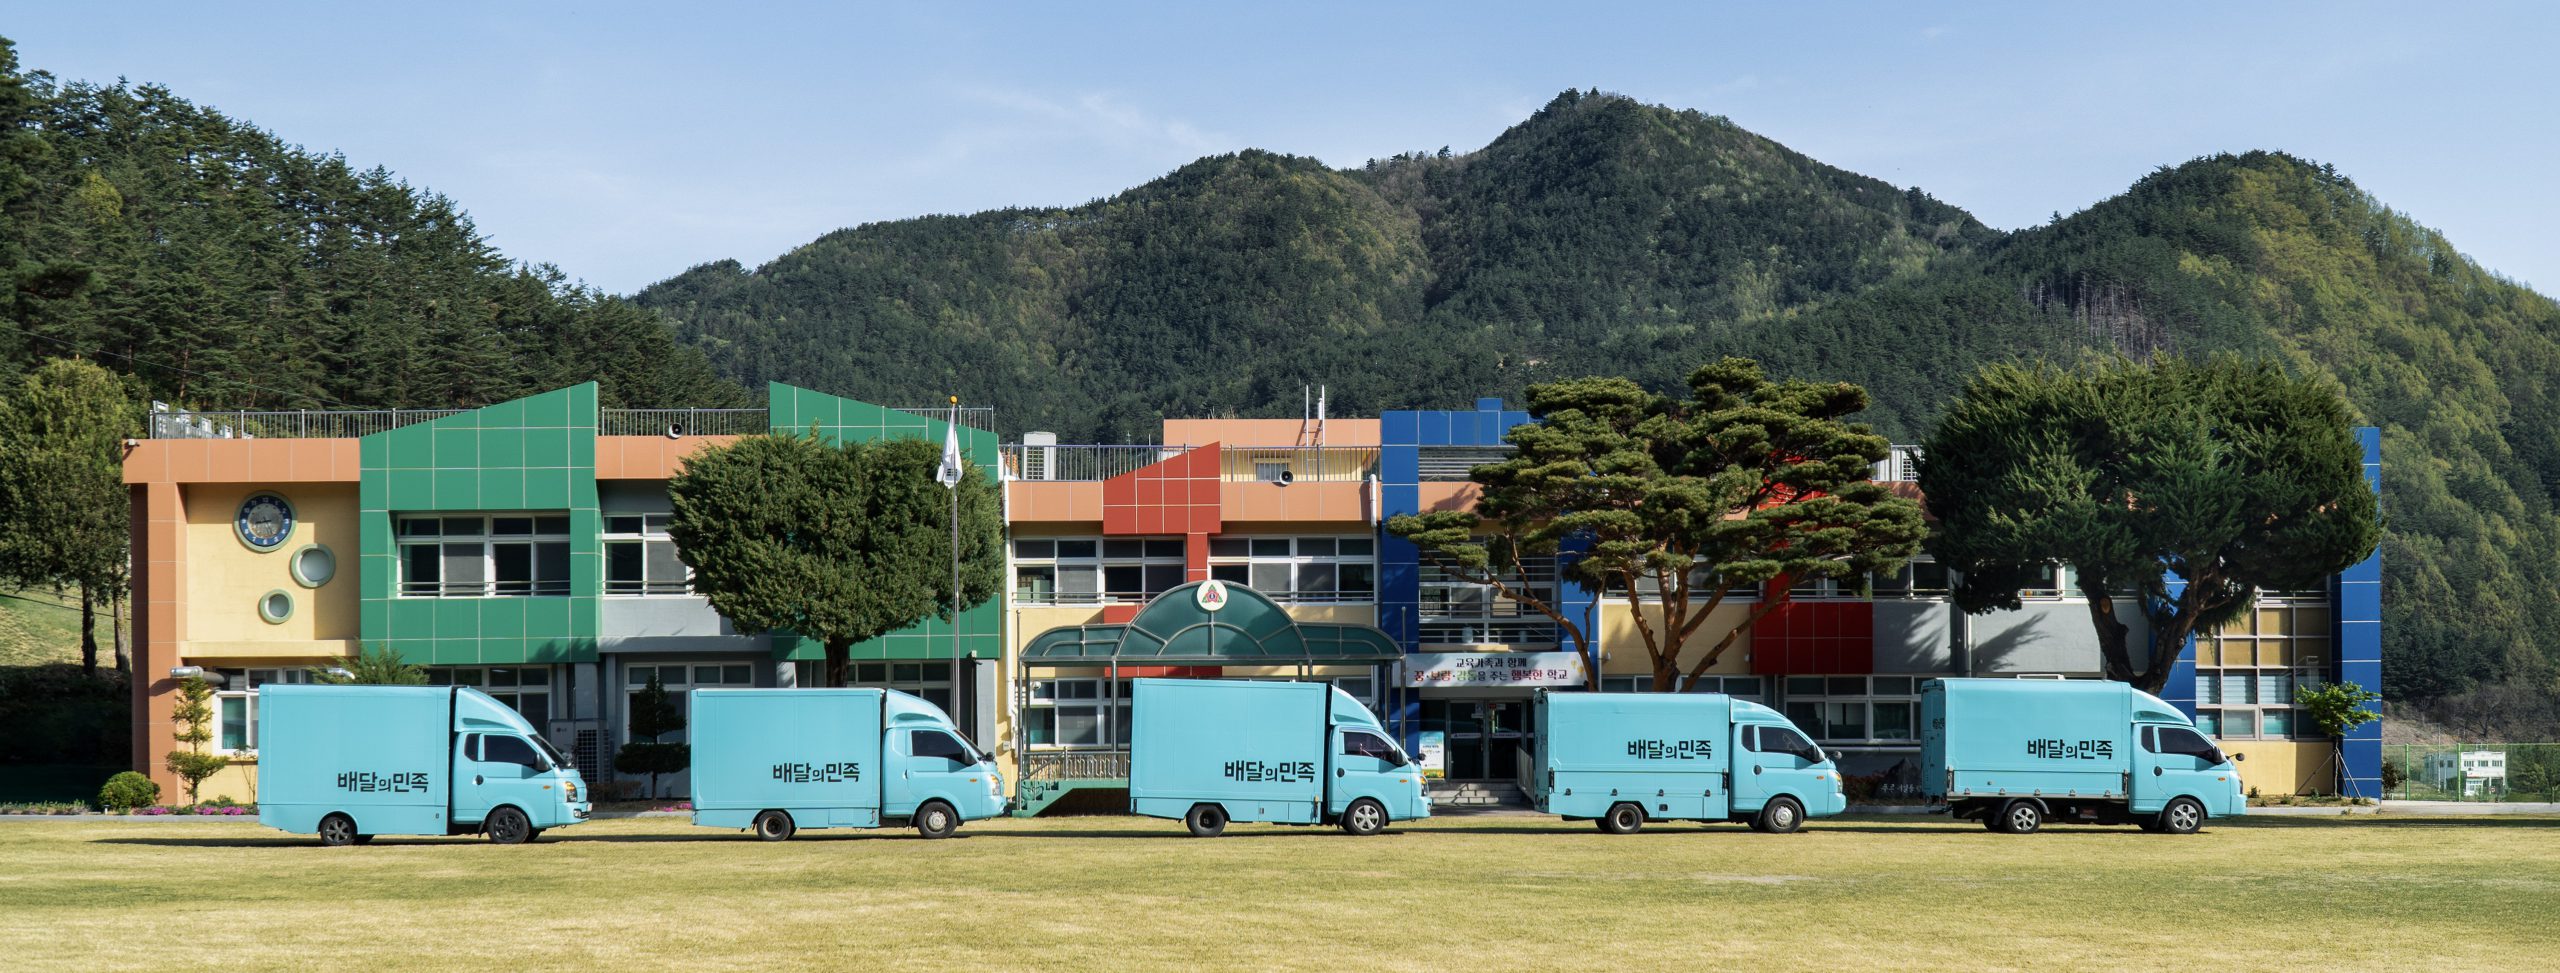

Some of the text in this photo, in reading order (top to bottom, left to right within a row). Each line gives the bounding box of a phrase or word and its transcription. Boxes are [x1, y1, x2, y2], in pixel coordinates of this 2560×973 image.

[1456, 657, 1527, 668] 교육가족과 함께
[1490, 670, 1508, 681] 주는
[1511, 669, 1543, 681] 행복한
[1547, 669, 1568, 680] 학교
[1628, 739, 1711, 760] 배달의민족
[2027, 738, 2112, 760] 배달의민족
[338, 771, 428, 793] 배달의민족
[773, 762, 860, 783] 배달의민족
[1225, 760, 1315, 783] 배달의민족
